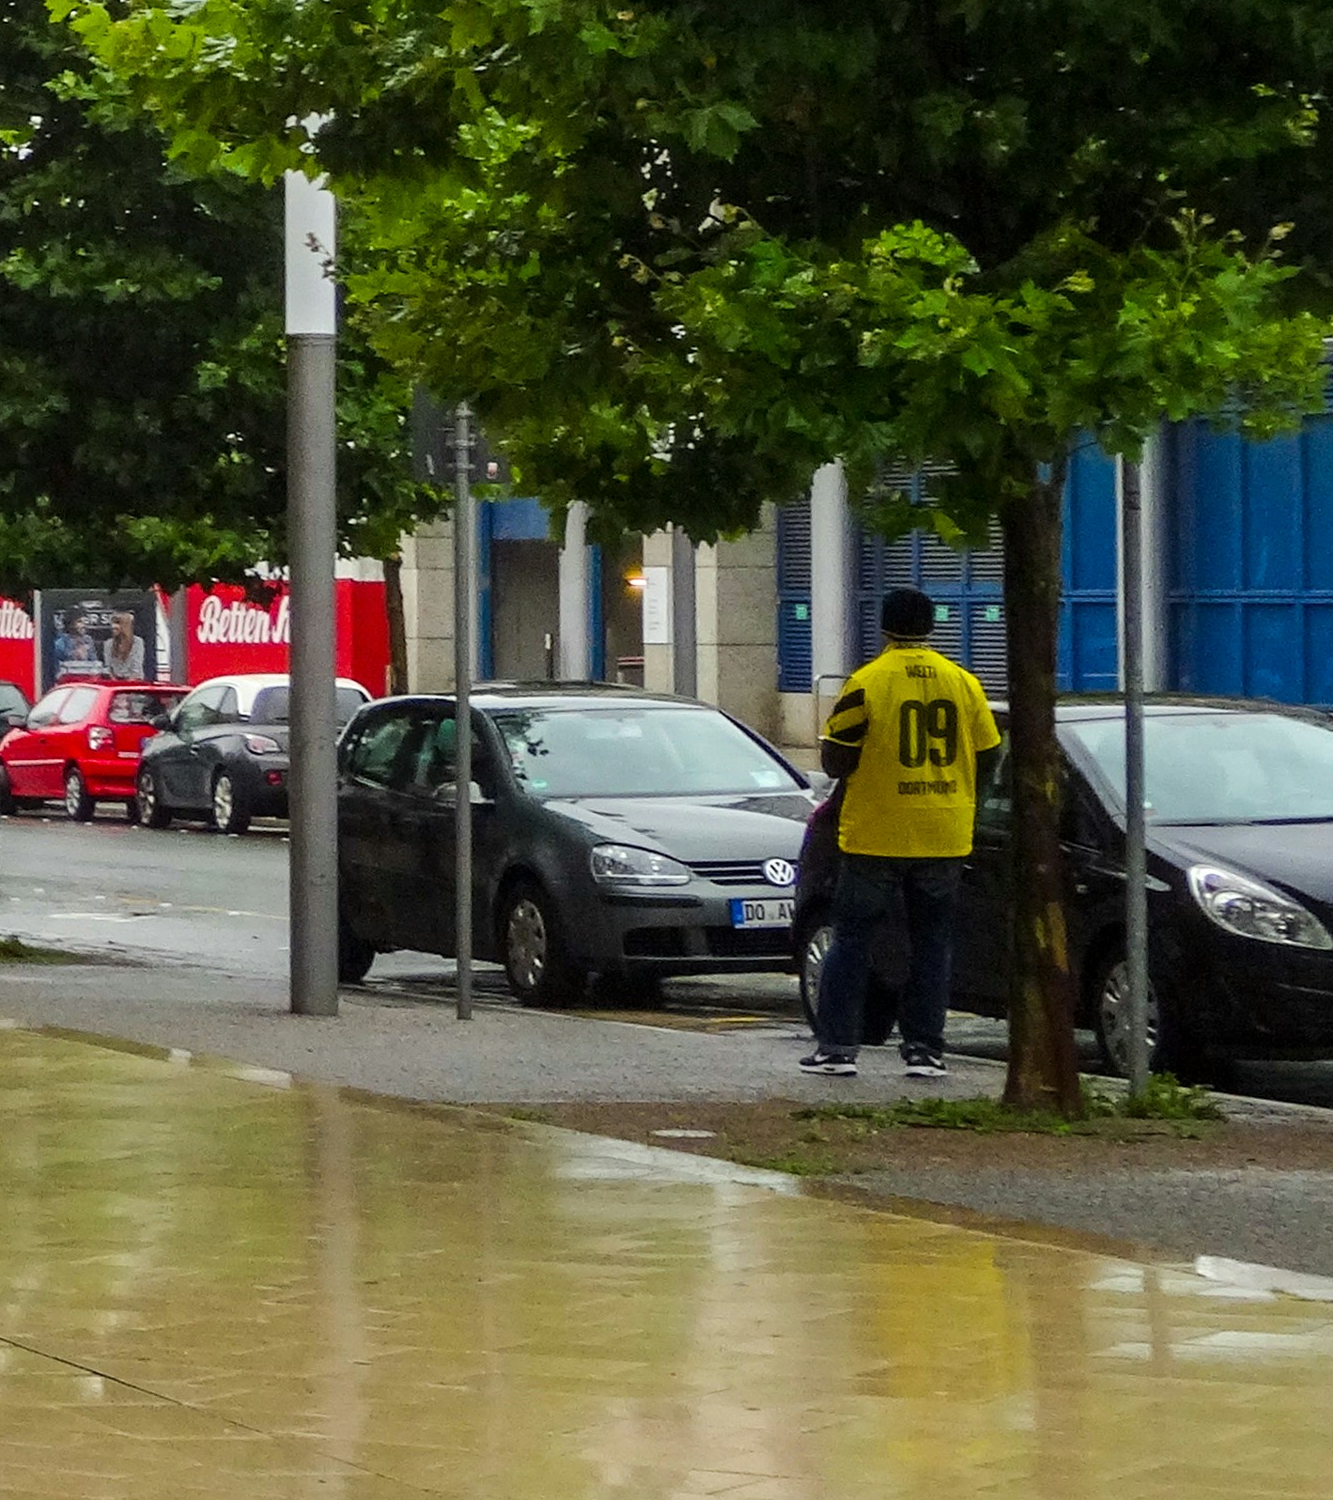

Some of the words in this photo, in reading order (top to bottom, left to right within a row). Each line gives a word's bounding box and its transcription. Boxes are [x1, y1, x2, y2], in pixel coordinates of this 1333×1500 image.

[197, 595, 271, 644] Betten
[899, 699, 958, 768] 09
[898, 780, 957, 795] DORTMUND
[744, 903, 765, 921] DO
